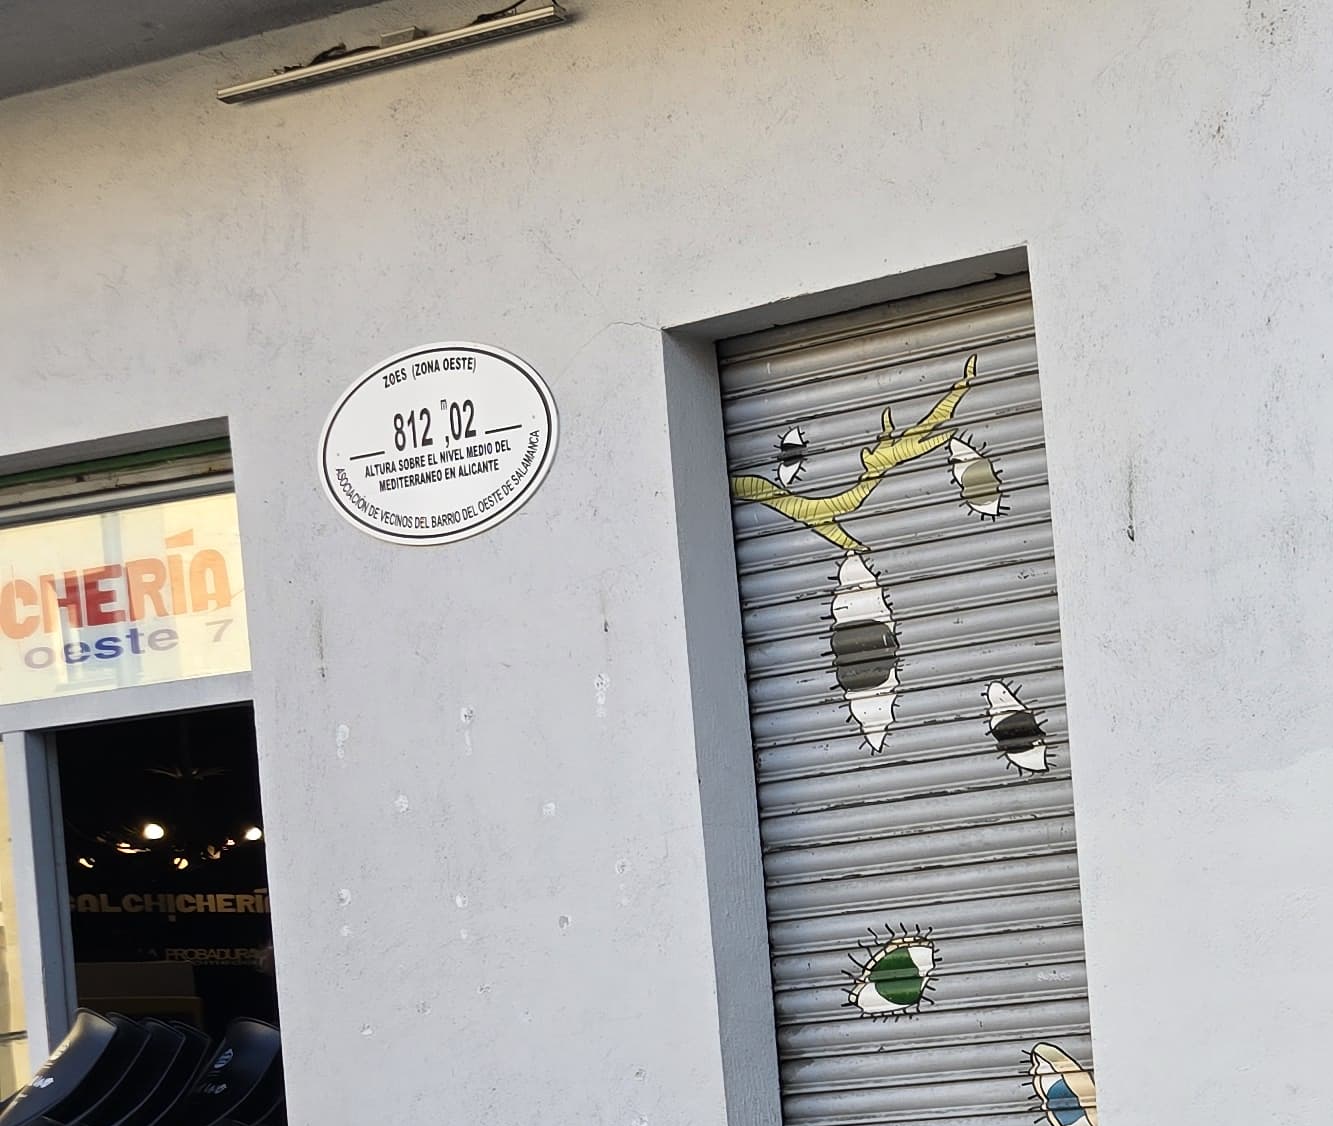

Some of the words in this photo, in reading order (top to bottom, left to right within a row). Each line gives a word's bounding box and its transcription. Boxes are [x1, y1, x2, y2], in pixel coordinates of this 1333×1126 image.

[382, 367, 407, 389] ZOES
[412, 359, 441, 380] (ZONA
[443, 357, 477, 373] OESTE)
[393, 407, 434, 452] 812
[365, 460, 397, 478] ALTURA
[398, 456, 426, 471] SOBRE
[427, 453, 439, 466] EL
[439, 448, 464, 463] NIVEL
[466, 442, 493, 458] MEDIO
[495, 439, 511, 453] DEL
[368, 504, 381, 520] DE
[380, 509, 413, 529] VECINOS
[414, 516, 430, 529] DEL
[431, 510, 461, 528] BARRIO
[462, 505, 479, 521] DEL
[478, 490, 504, 513] OESTE
[501, 479, 515, 496] DE
[511, 429, 541, 486] SALAMANCA
[379, 469, 443, 493] MEDITERRANEO
[445, 466, 456, 480] EN
[458, 458, 500, 478] ALICANTE
[24, 626, 179, 670] oeste
[204, 618, 234, 643] 7
